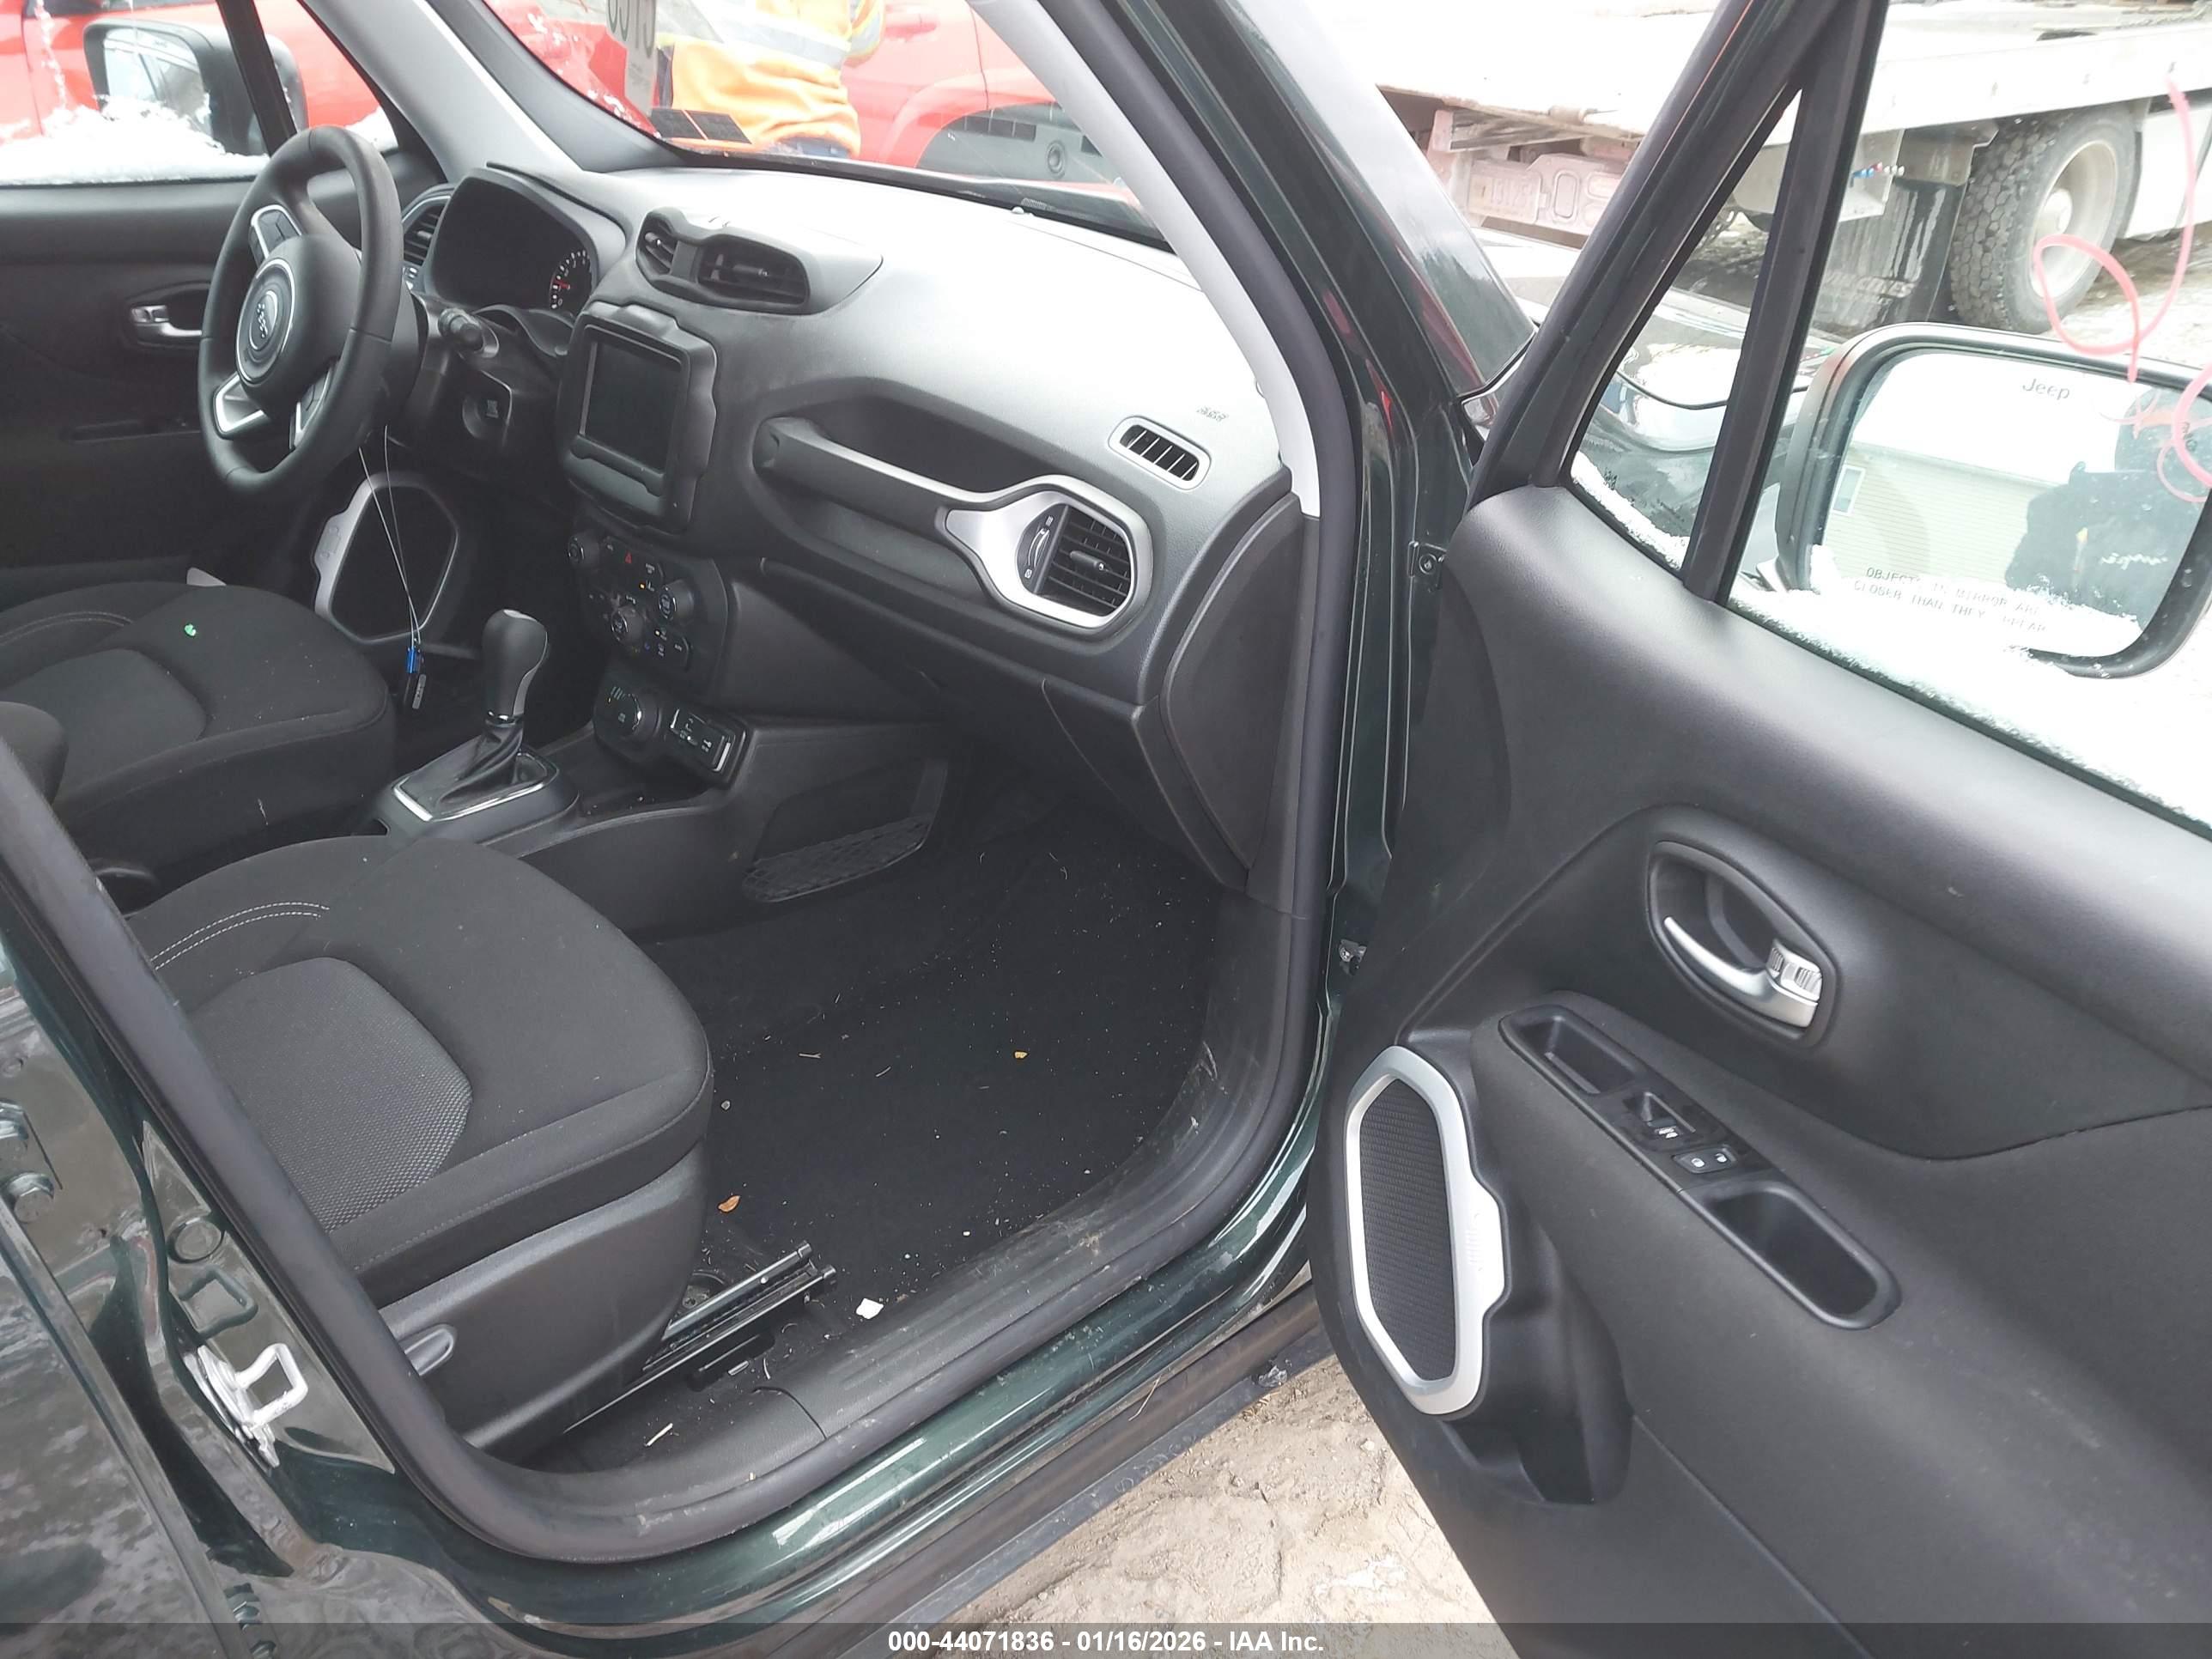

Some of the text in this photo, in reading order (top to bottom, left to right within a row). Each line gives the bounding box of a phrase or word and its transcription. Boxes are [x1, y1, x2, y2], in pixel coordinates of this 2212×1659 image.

[2022, 378, 2070, 401] Jeep
[1853, 580, 2048, 632] CLOSER THAN THEY PEAR
